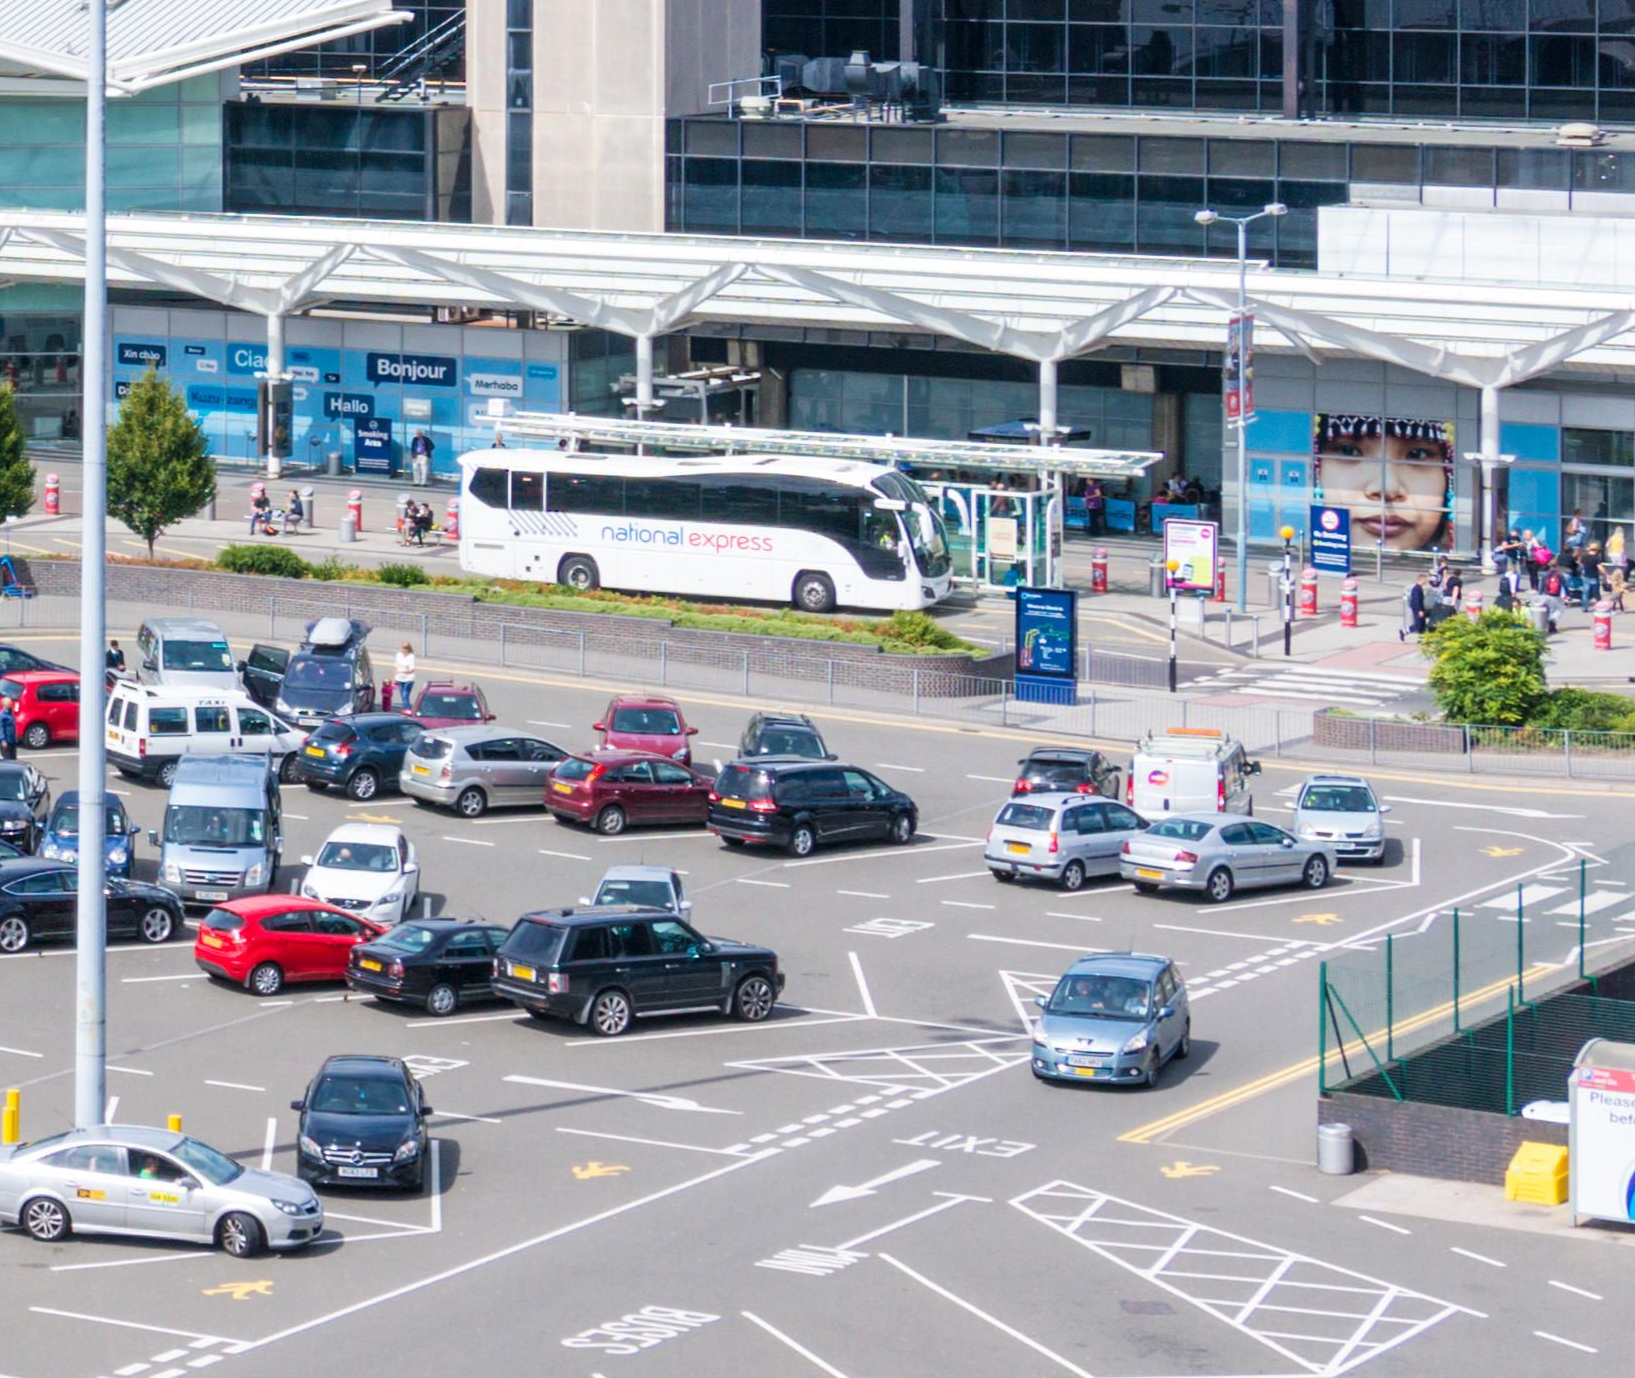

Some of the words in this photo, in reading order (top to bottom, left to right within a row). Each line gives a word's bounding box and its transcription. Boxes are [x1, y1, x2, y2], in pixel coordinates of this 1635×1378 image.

[377, 359, 447, 381] Bonjour
[475, 379, 518, 391] Merhaba
[331, 397, 369, 414] Hallo
[602, 523, 684, 545] national
[689, 532, 773, 553] express
[893, 1131, 1036, 1158] EXIT
[560, 1304, 722, 1355] BUSES
